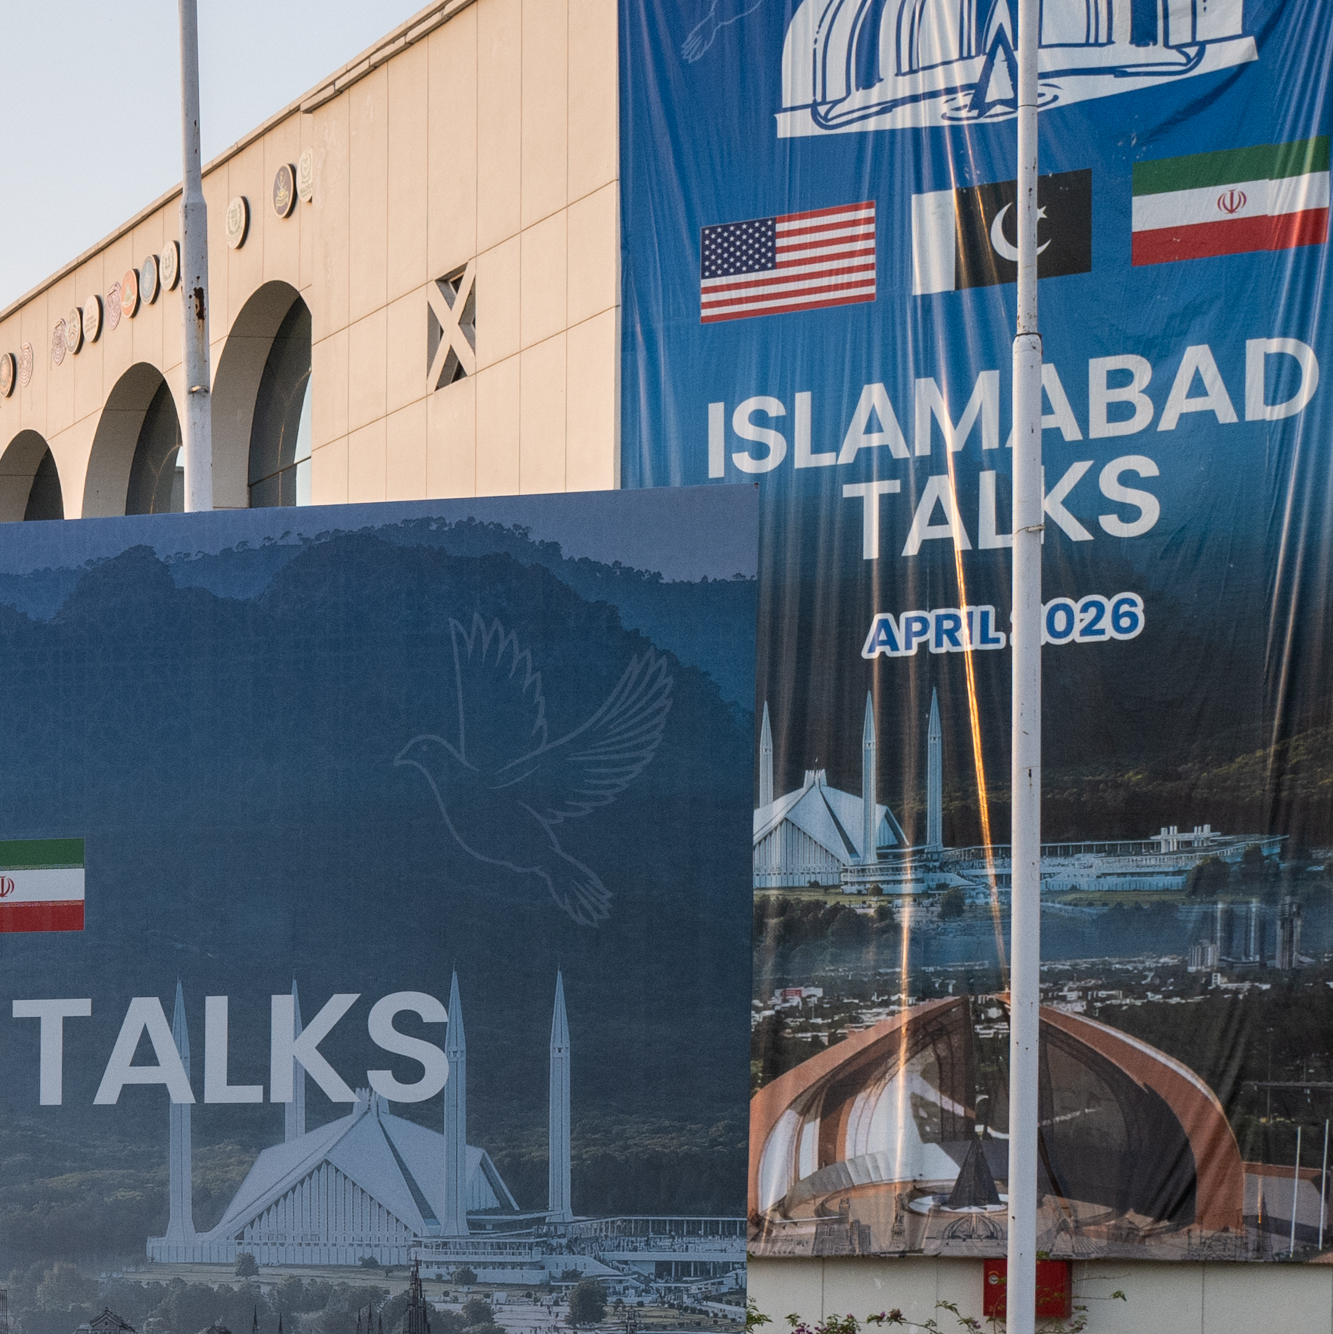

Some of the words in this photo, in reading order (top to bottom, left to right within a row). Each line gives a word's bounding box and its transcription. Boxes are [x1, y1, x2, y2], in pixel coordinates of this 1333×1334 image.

[708, 337, 1320, 479] ISLAMABAD
[842, 454, 1161, 560] TALKS
[861, 605, 1007, 659] APRIL
[1011, 592, 1145, 648] 026
[12, 990, 451, 1108] TALKS
